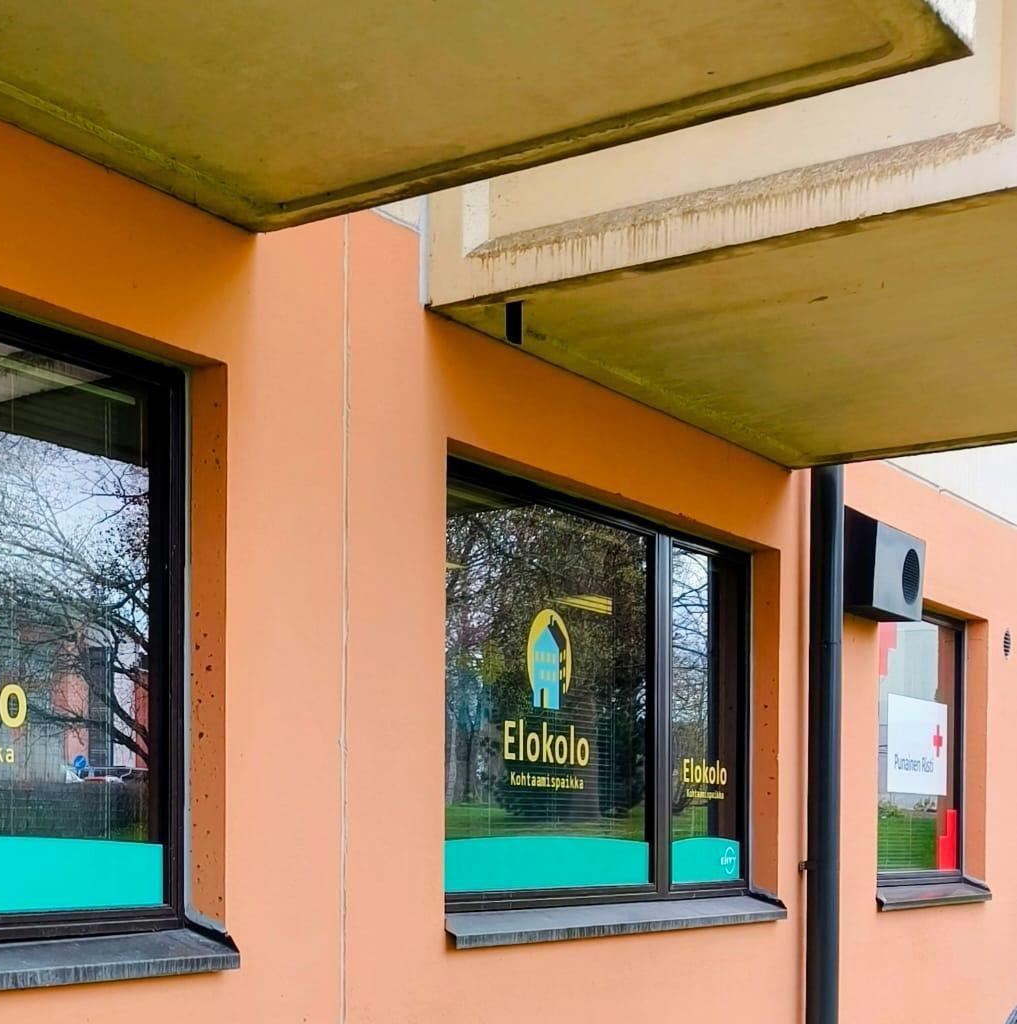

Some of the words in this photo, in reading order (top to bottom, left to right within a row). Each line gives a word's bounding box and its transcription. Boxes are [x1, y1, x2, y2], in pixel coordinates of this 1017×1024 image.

[503, 718, 590, 766] Elokolo
[683, 757, 728, 786] Elokolo
[894, 754, 921, 772] Punainen
[510, 771, 584, 790] Kohtaamispaikka
